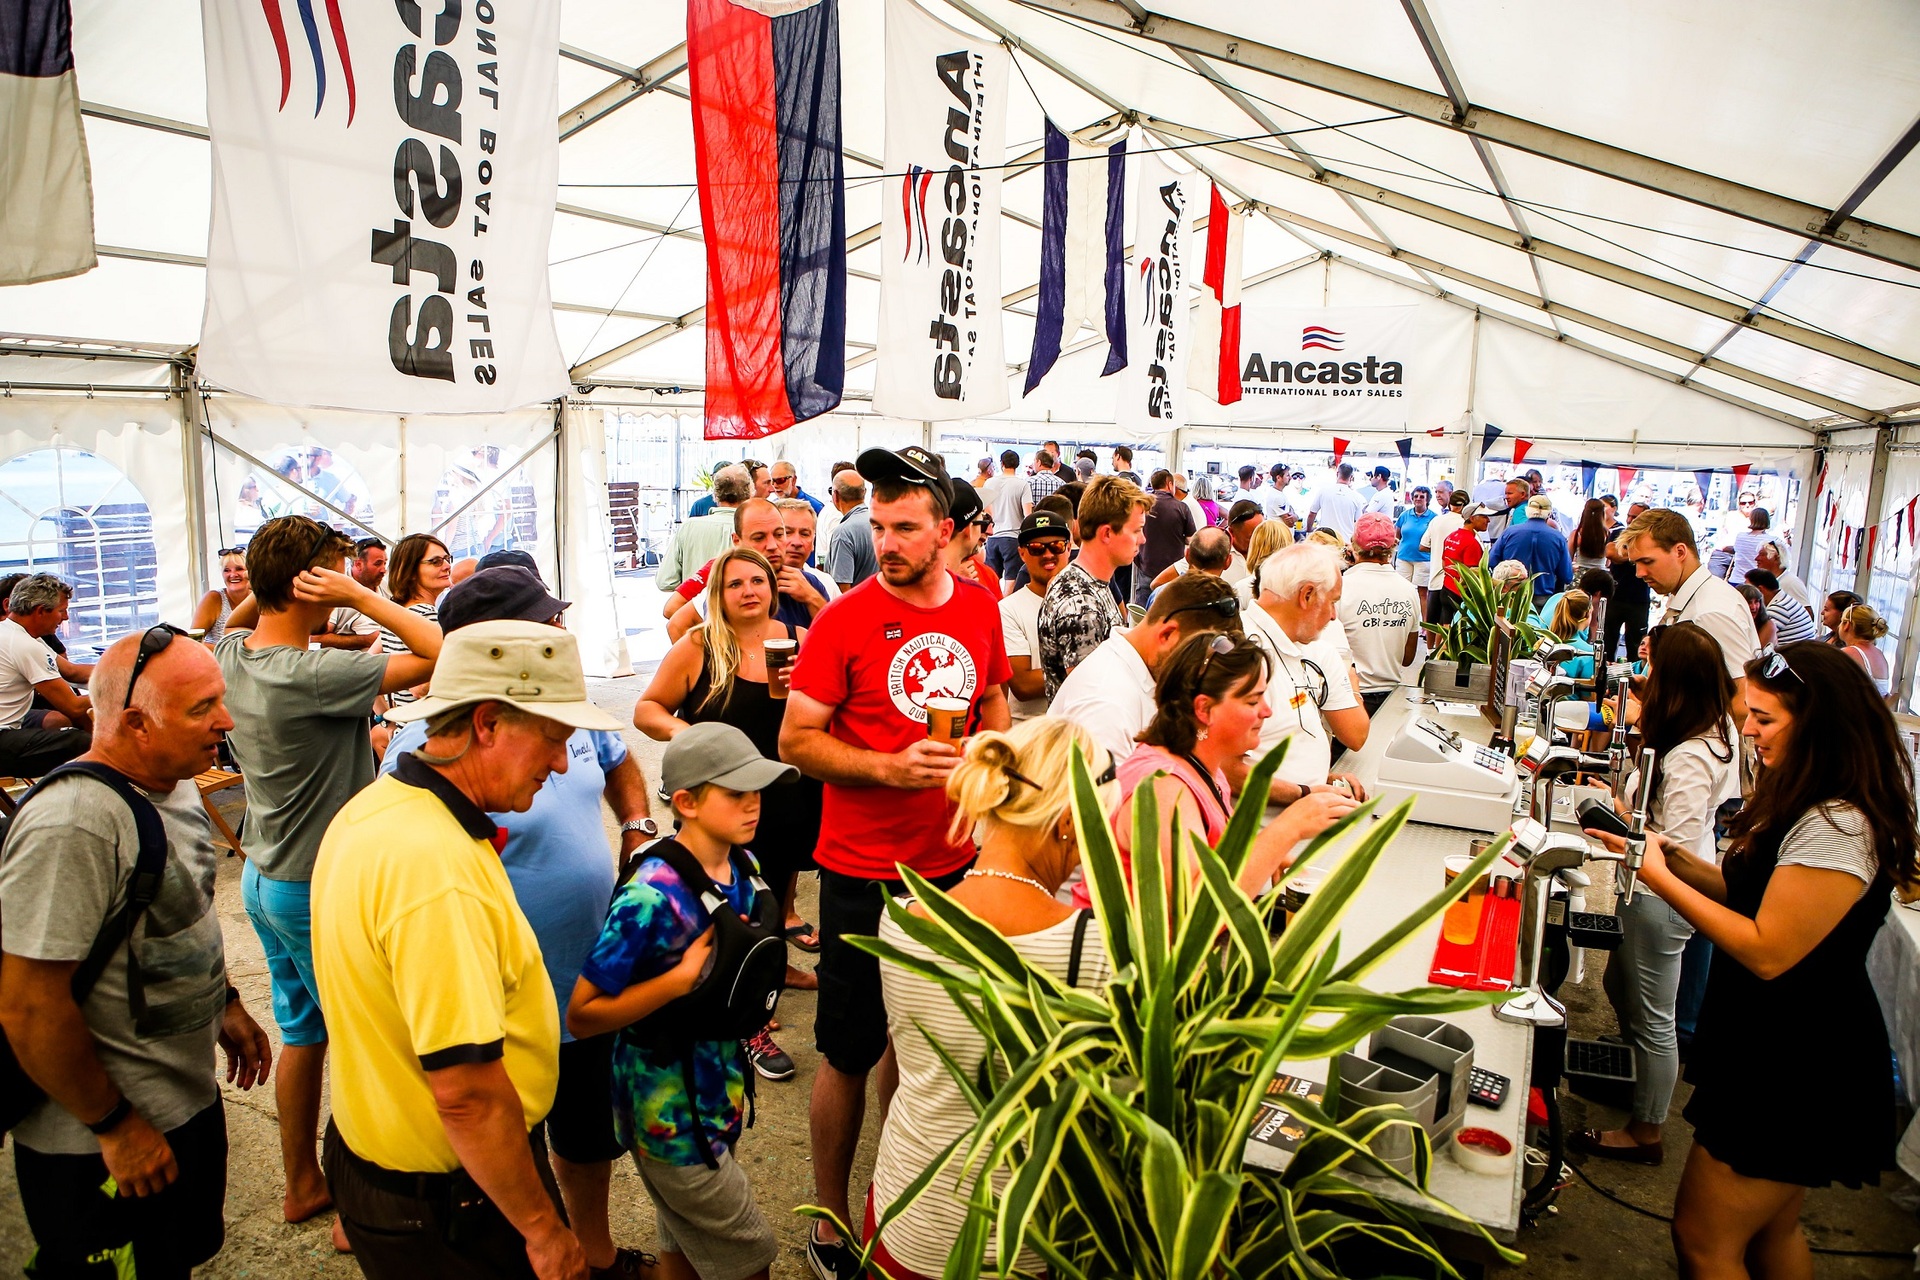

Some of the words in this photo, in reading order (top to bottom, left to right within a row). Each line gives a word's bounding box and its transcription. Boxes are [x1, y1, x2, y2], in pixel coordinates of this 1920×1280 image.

[1241, 352, 1403, 385] Ancasta
[1333, 389, 1362, 397] BOAT
[1367, 389, 1403, 398] SALES
[906, 449, 931, 464] CAT
[890, 657, 907, 697] BRITISH
[902, 634, 947, 657] NAUTICAL
[949, 641, 977, 691] OUTFITTERS
